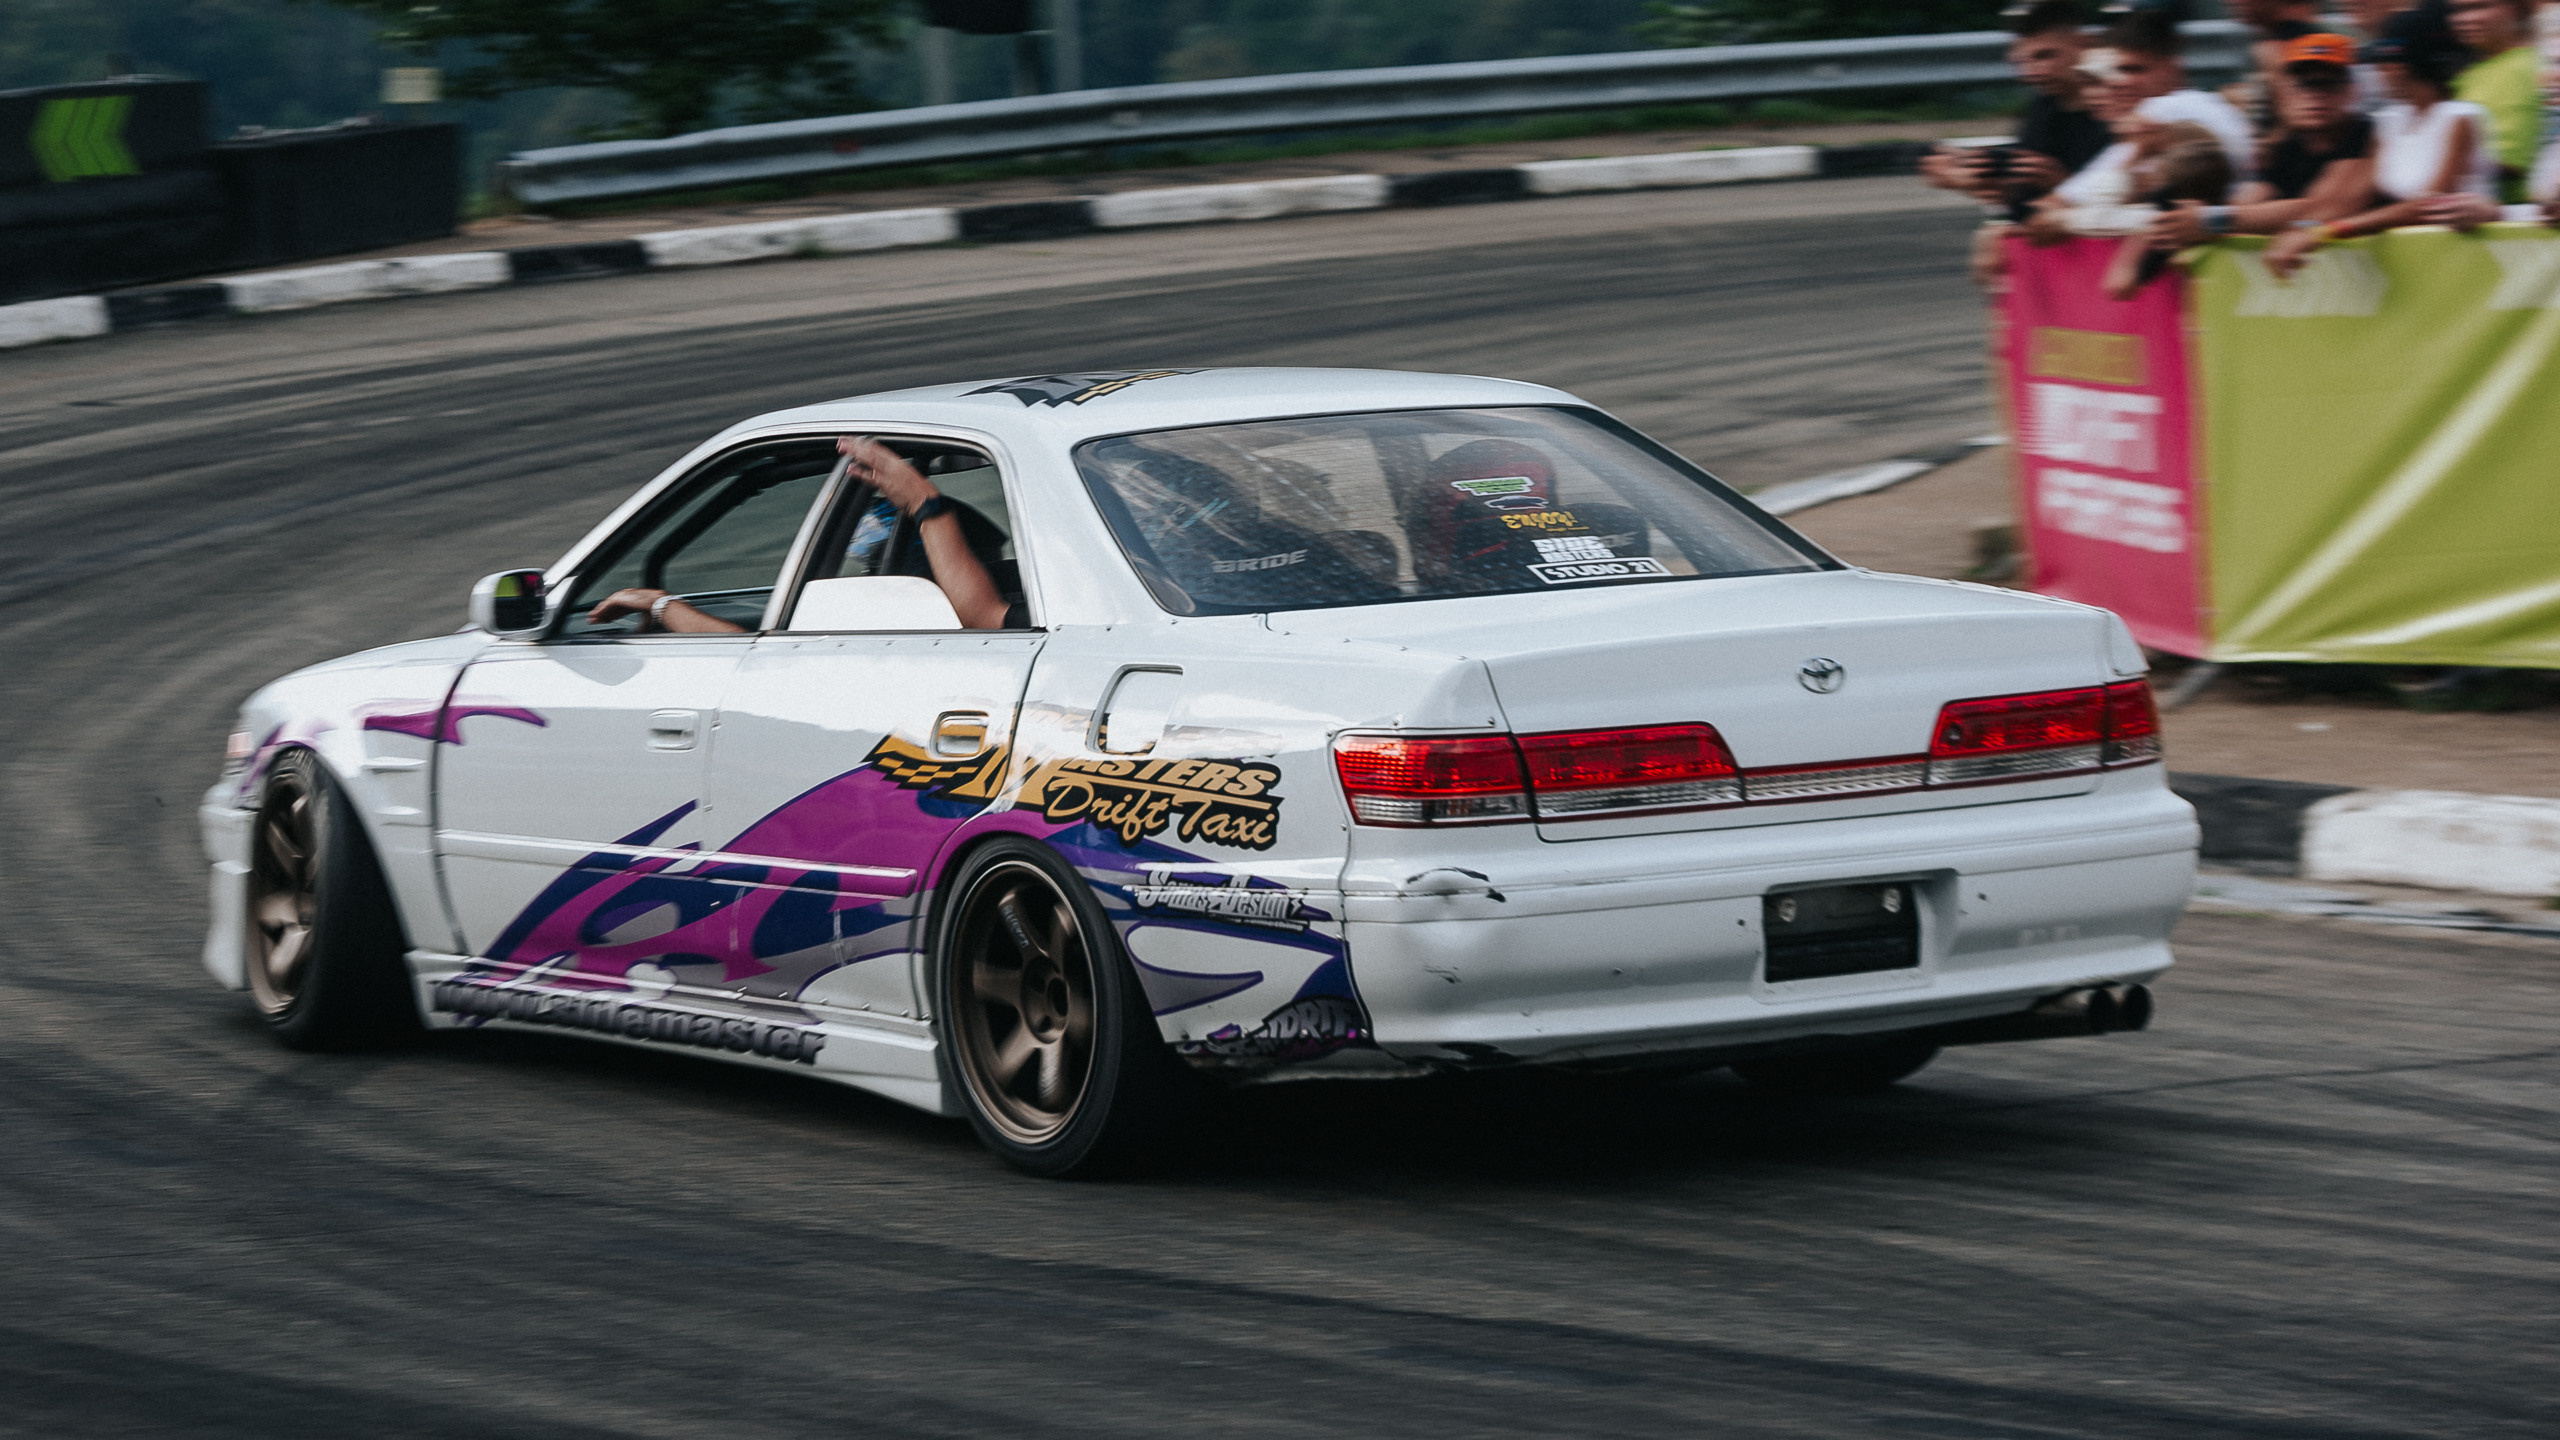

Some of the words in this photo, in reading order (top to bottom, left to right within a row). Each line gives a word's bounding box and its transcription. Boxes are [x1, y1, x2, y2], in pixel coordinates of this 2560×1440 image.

[1212, 549, 1308, 574] BRIDE
[1544, 563, 1630, 578] STUDIO
[1627, 561, 1660, 573] 21
[1046, 774, 1170, 842] Drift
[1172, 793, 1277, 844] Taxi
